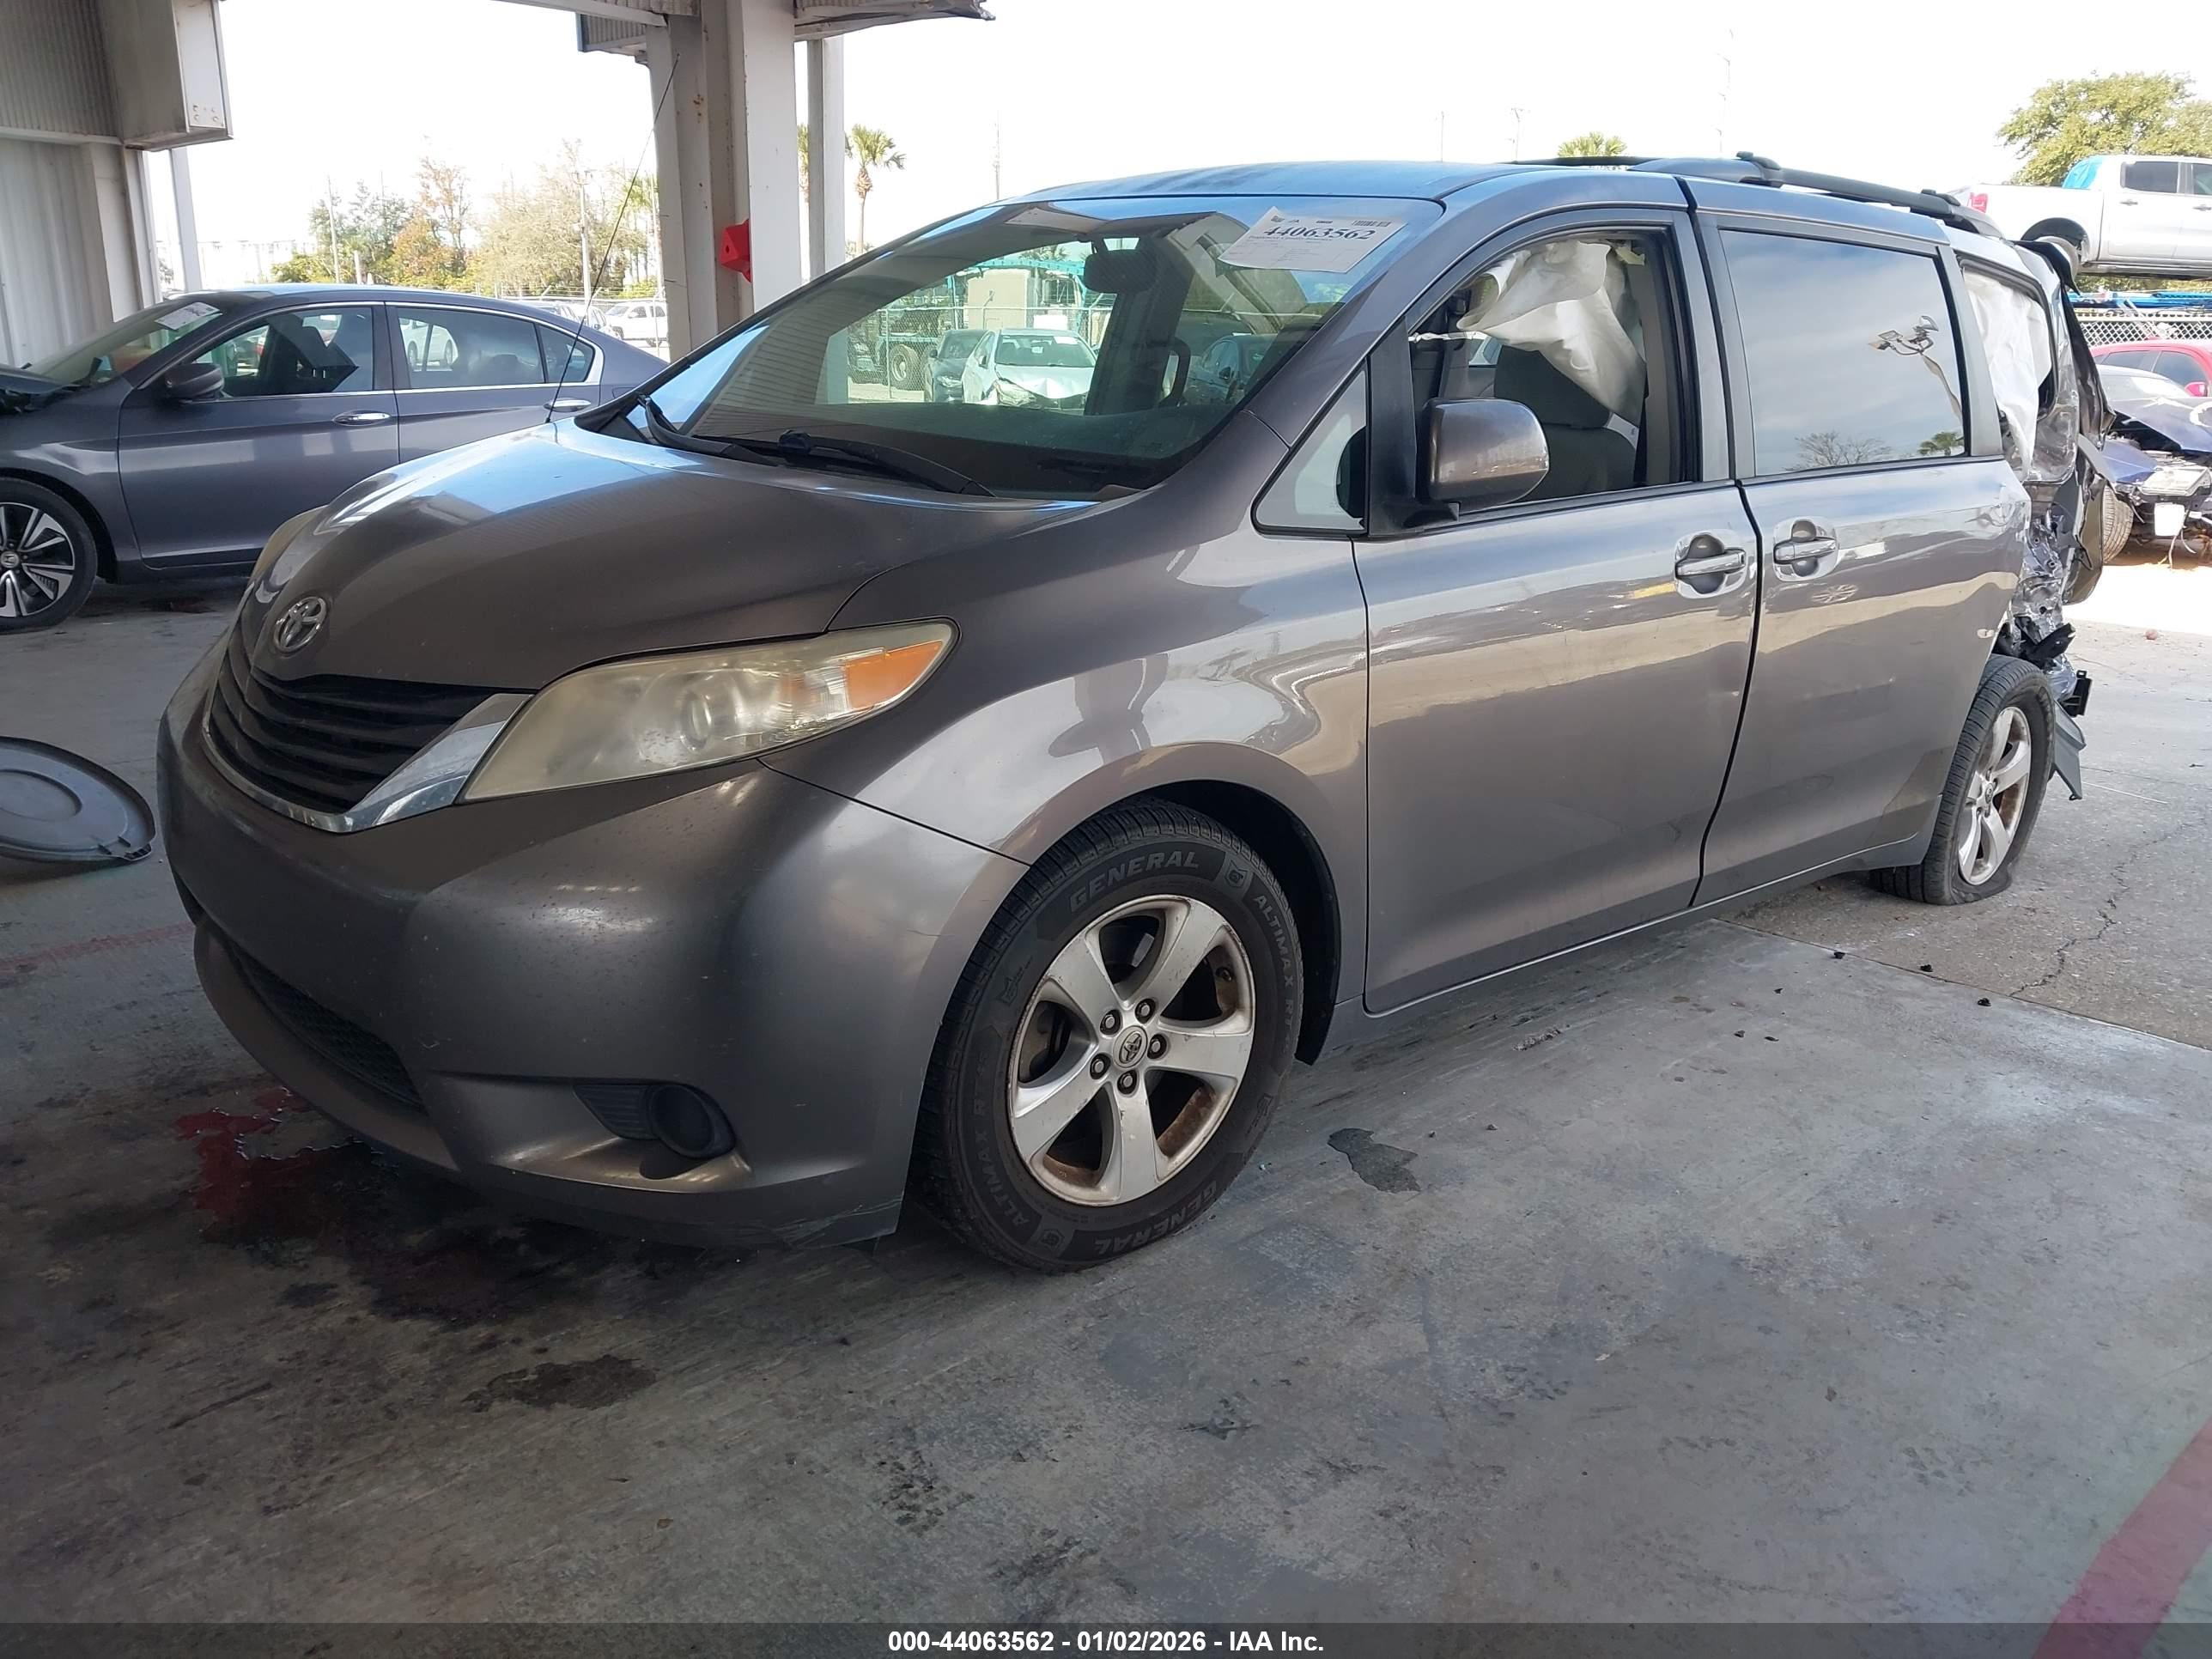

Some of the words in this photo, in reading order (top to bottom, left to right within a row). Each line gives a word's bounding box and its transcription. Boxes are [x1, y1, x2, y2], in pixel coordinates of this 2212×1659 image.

[1264, 226, 1376, 240] 44063562
[1069, 850, 1200, 913] GENERAL
[1254, 894, 1293, 988] ALTIMAX
[975, 1131, 1030, 1228] ALTIMAX
[1094, 1180, 1218, 1255] GENERAL
